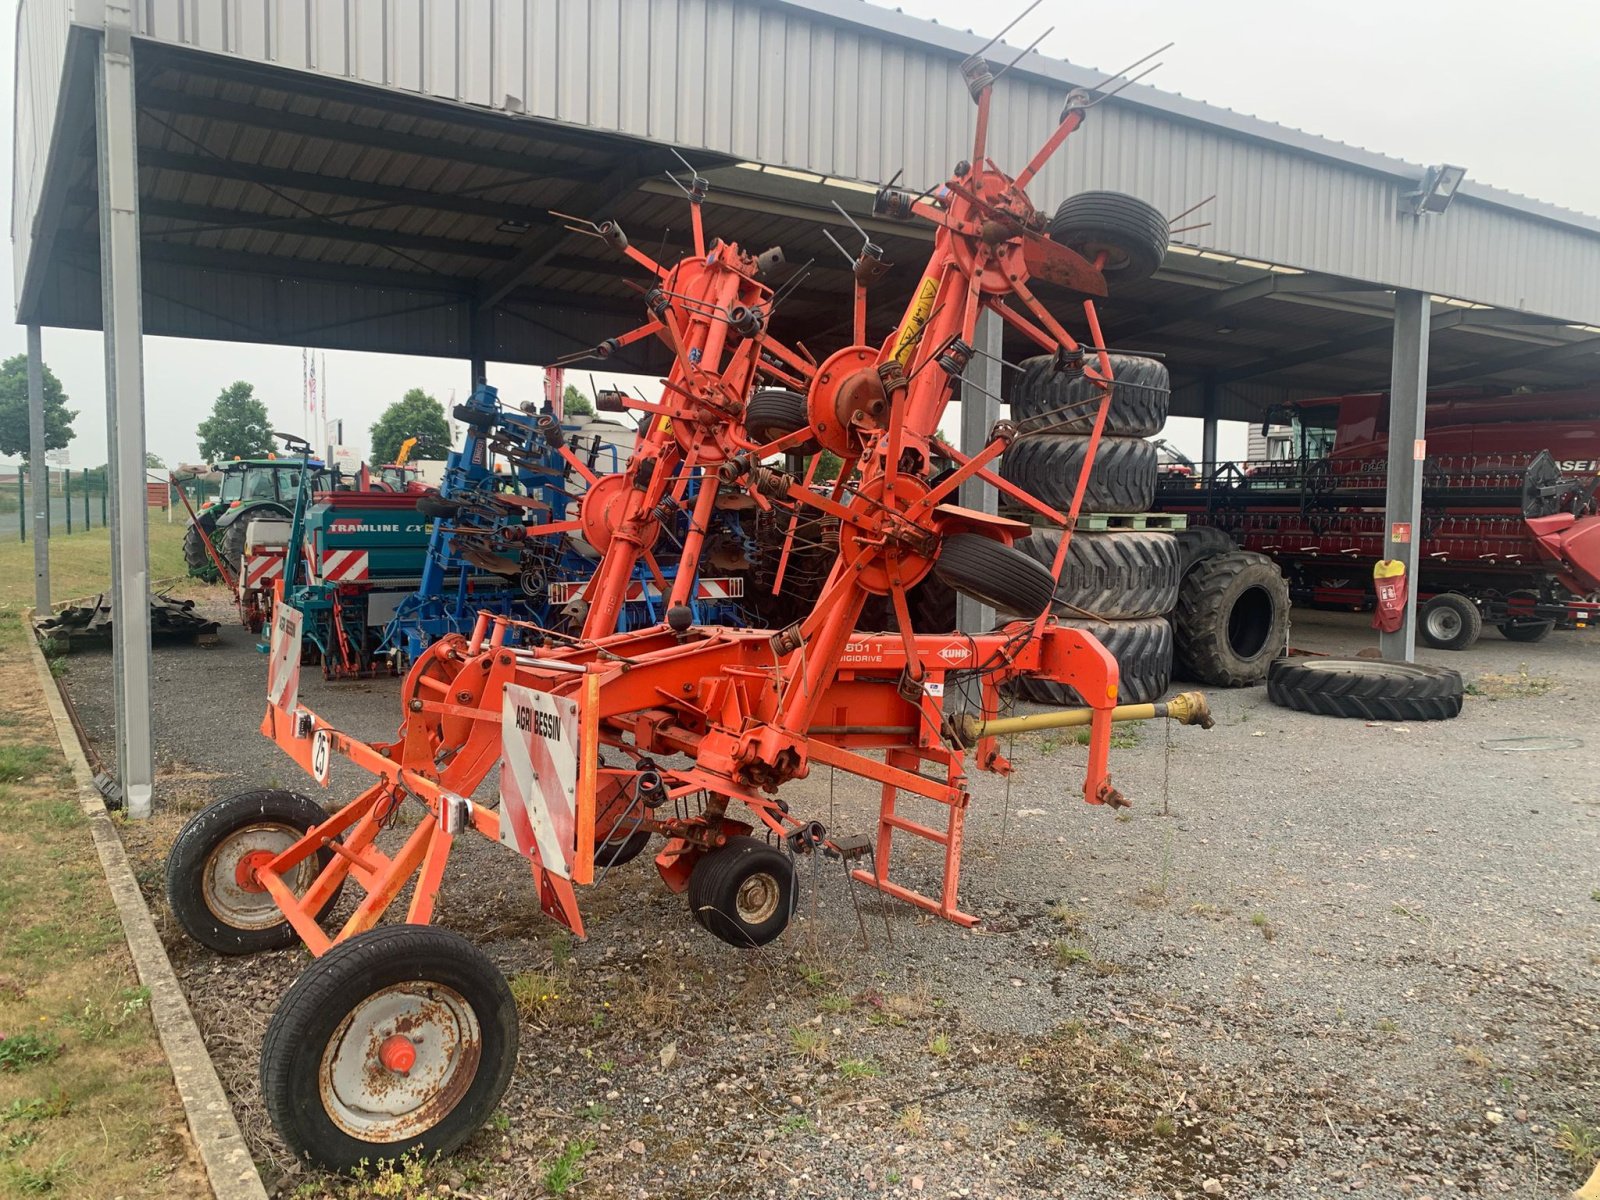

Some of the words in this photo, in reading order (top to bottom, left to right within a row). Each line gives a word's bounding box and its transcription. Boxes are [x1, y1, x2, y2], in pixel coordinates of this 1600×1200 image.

[329, 524, 400, 532] TRAMLINE
[405, 524, 424, 532] CX
[875, 643, 882, 653] T
[941, 649, 968, 659] KUHN
[515, 704, 533, 733] AGRI
[534, 709, 561, 742] BESSIN
[315, 731, 326, 776] 25
